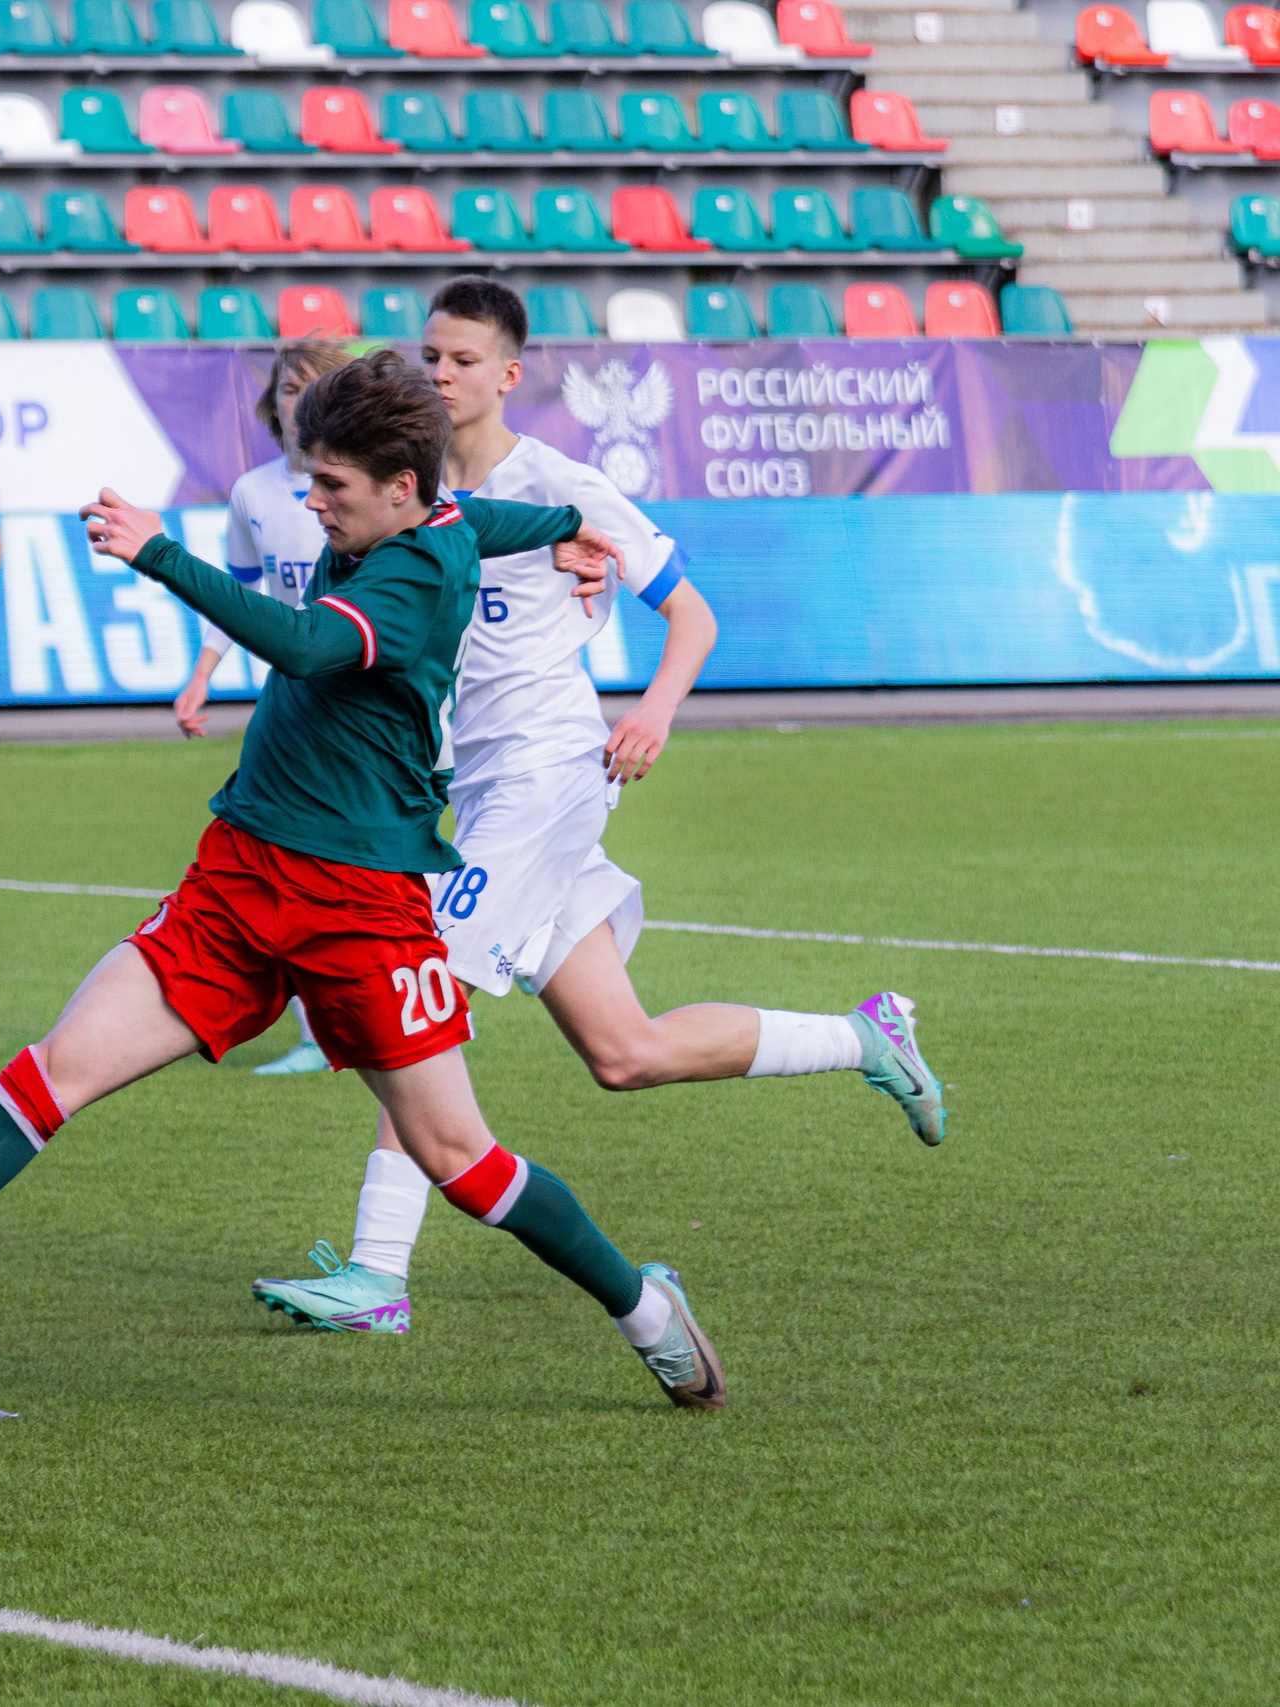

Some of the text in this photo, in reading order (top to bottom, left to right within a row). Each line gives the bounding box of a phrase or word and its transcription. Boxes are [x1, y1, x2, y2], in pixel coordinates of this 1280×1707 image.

[696, 361, 936, 407] РОССИЙСКИЙ
[699, 404, 952, 453] ФУТБОЛЬНЫЙ
[704, 457, 811, 499] СОЮЗ
[280, 561, 313, 589] ВТ
[435, 864, 488, 920] 18
[391, 957, 456, 1037] 20
